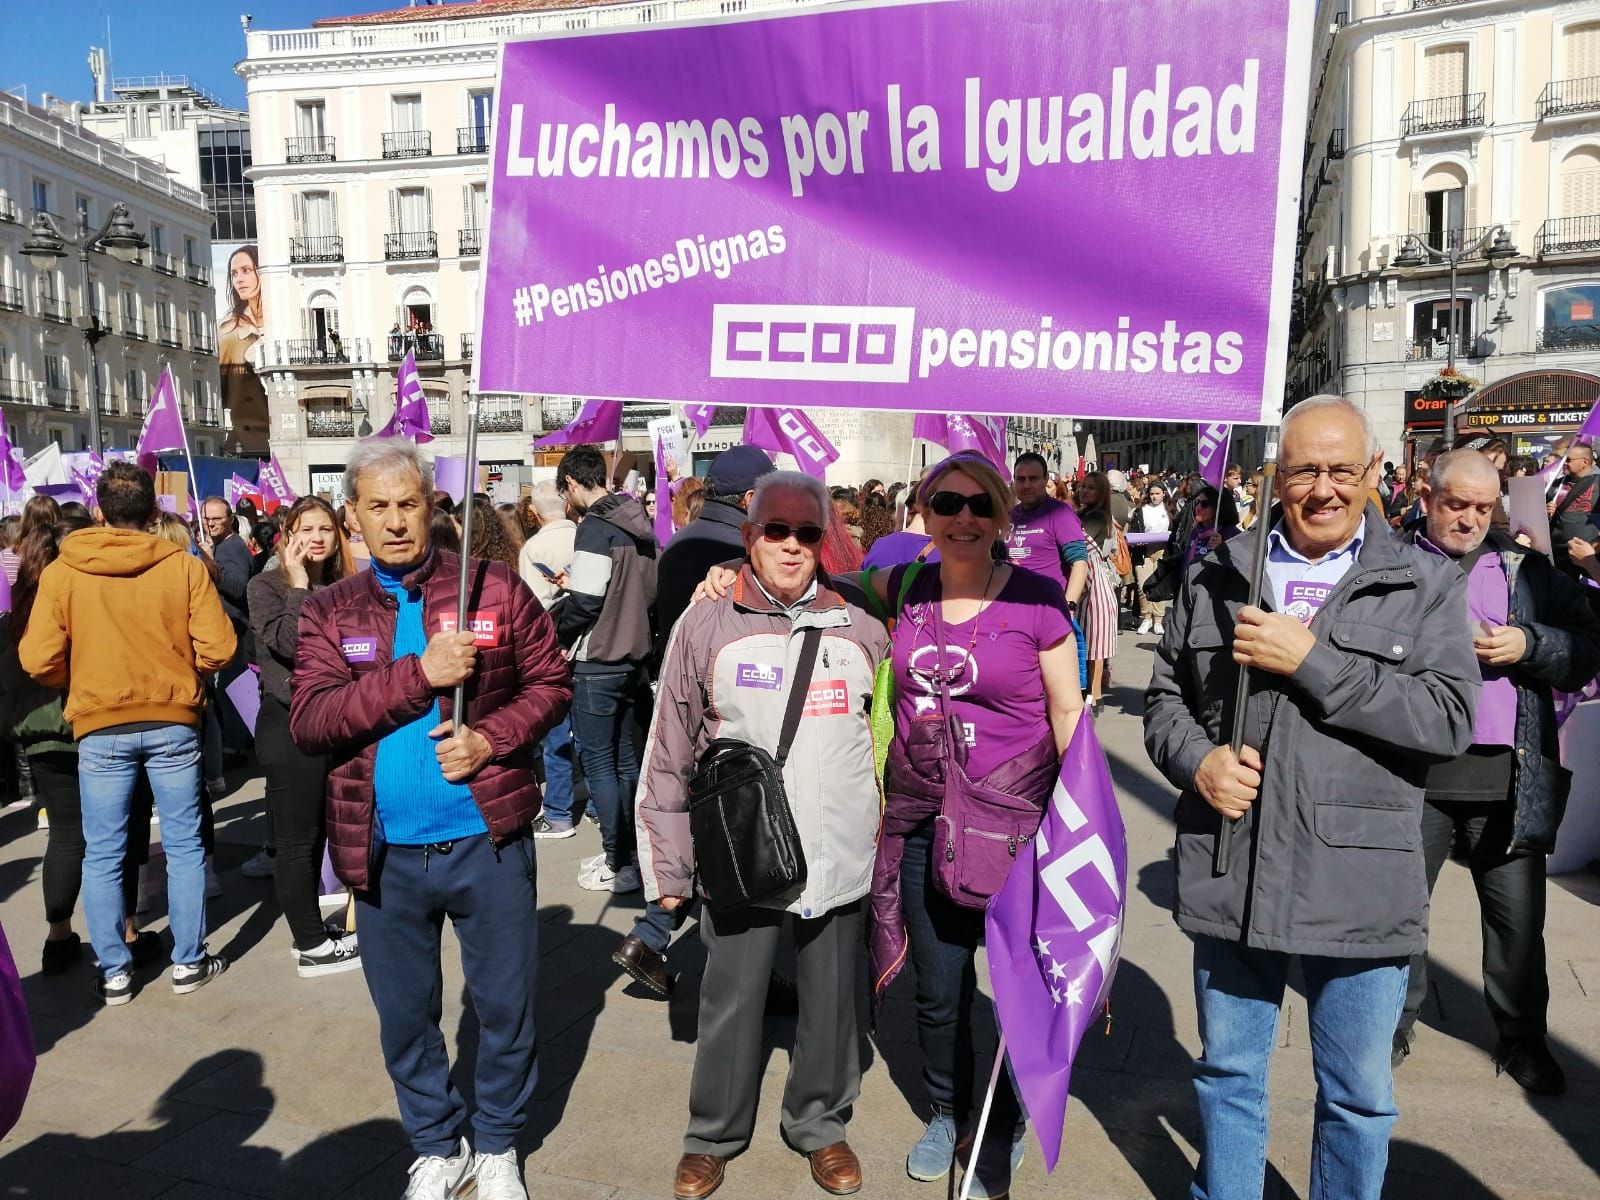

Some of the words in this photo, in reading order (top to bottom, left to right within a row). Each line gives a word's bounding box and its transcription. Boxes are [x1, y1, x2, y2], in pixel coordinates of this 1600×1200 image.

[505, 103, 770, 180] Luchamos
[780, 110, 870, 198] por
[887, 83, 942, 174] la
[964, 58, 1260, 193] Igualdad
[512, 224, 788, 328] #PensionesDignas
[722, 318, 900, 367] CCOO
[917, 316, 1245, 379] pensionistas
[1479, 415, 1500, 425] TOP
[1501, 413, 1536, 425] TOURS
[1537, 413, 1547, 423] &
[1549, 411, 1590, 423] TICKETS
[442, 619, 494, 633] COO
[742, 668, 777, 681] CCOO
[805, 688, 845, 703] COO
[803, 701, 846, 711] ensionistas
